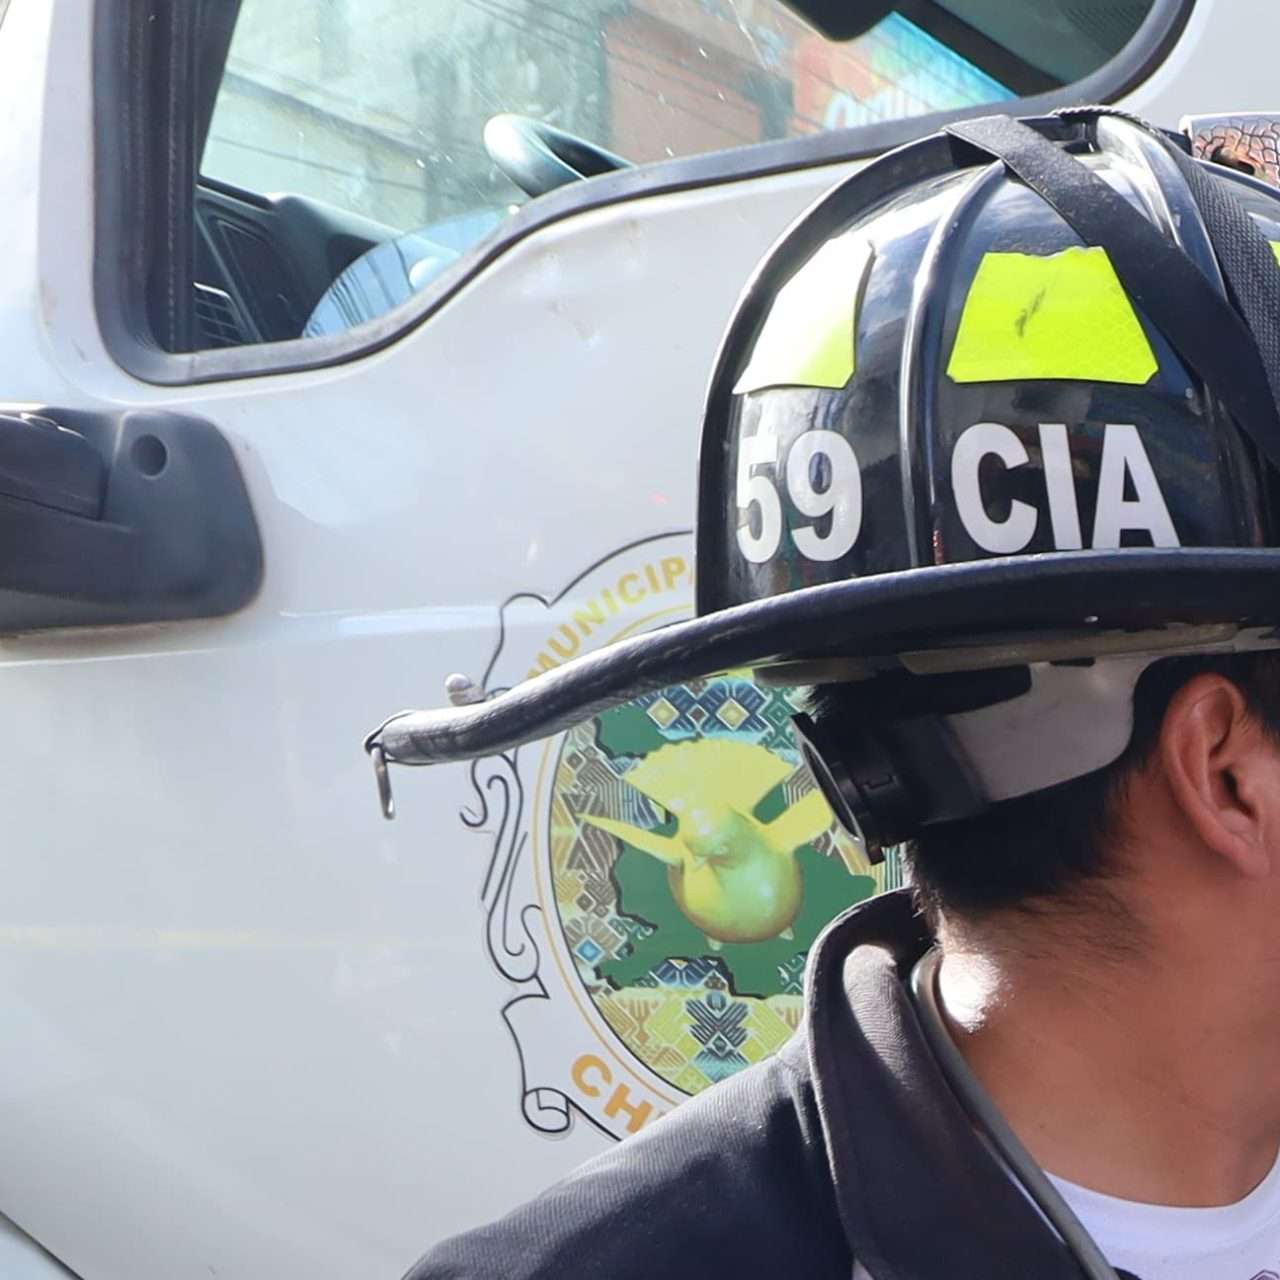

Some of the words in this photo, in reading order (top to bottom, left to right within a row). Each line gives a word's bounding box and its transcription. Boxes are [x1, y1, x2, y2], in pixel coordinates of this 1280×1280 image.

[735, 430, 863, 564] 59
[951, 422, 1182, 553] CIA
[527, 556, 694, 679] MUNICIP
